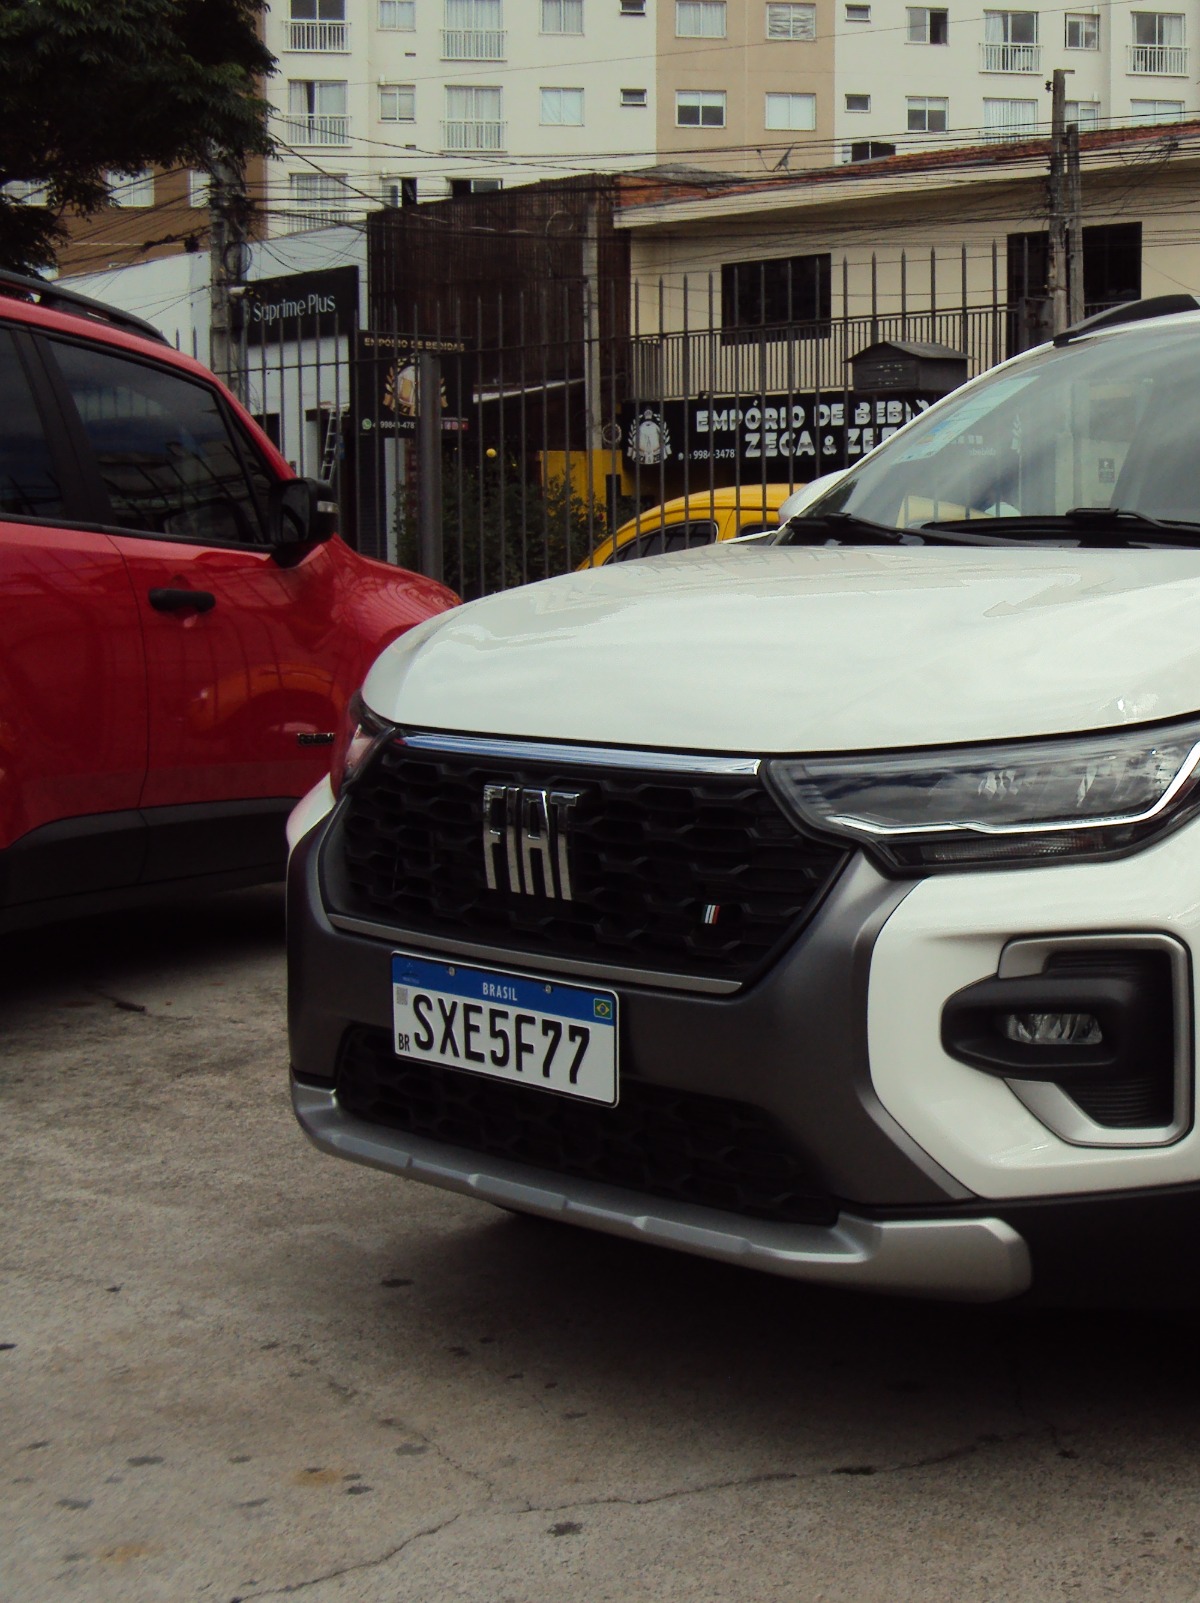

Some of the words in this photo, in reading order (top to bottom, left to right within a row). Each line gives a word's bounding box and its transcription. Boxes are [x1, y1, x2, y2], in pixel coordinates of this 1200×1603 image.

[253, 298, 306, 326] Suprime
[307, 293, 336, 314] Plus
[425, 341, 465, 352] BEIDAS
[696, 400, 805, 432] EMPÓRIO
[814, 403, 845, 427] DE
[744, 431, 816, 458] ZECA
[822, 435, 837, 455] &
[483, 784, 580, 901] FIAT
[482, 982, 518, 1001] BRASIL
[398, 1033, 410, 1052] BR
[413, 994, 590, 1084] SXE5F77
